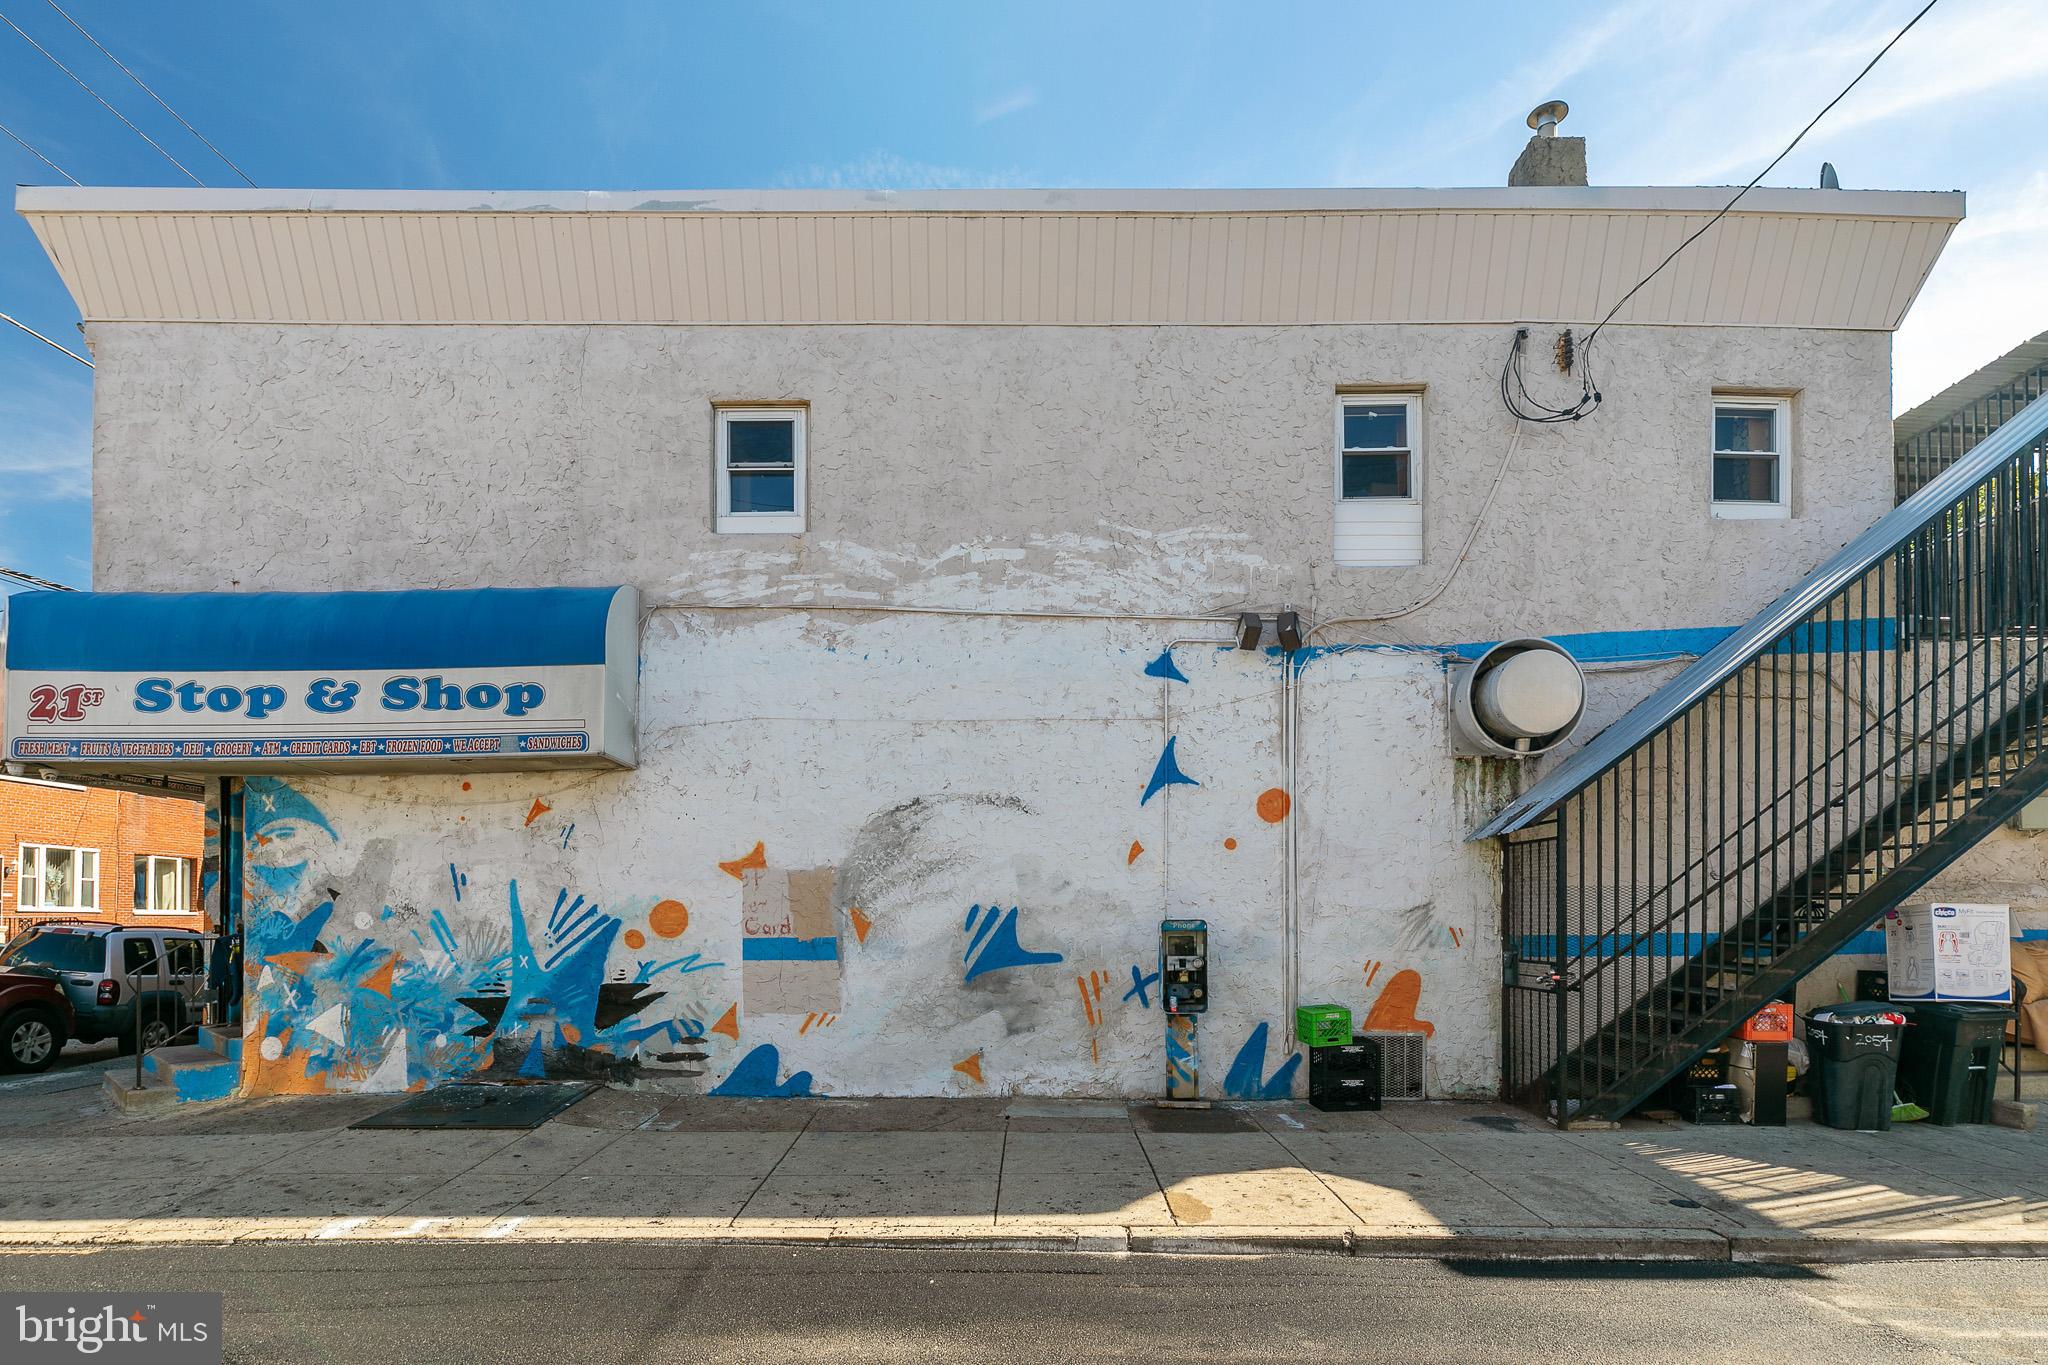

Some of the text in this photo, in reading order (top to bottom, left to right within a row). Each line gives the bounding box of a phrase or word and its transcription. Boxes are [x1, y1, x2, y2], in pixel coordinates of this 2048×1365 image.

[133, 677, 287, 719] Stop
[304, 677, 361, 713] &
[380, 674, 546, 717] Shop
[18, 736, 583, 756] FRESH MEAT FRUITS & VEGETABLES DELI GROCERY ATM CREDIT CARDS EBT FROZEN FOOD WE ACCEPT SANDWICHES
[745, 914, 792, 936] Card
